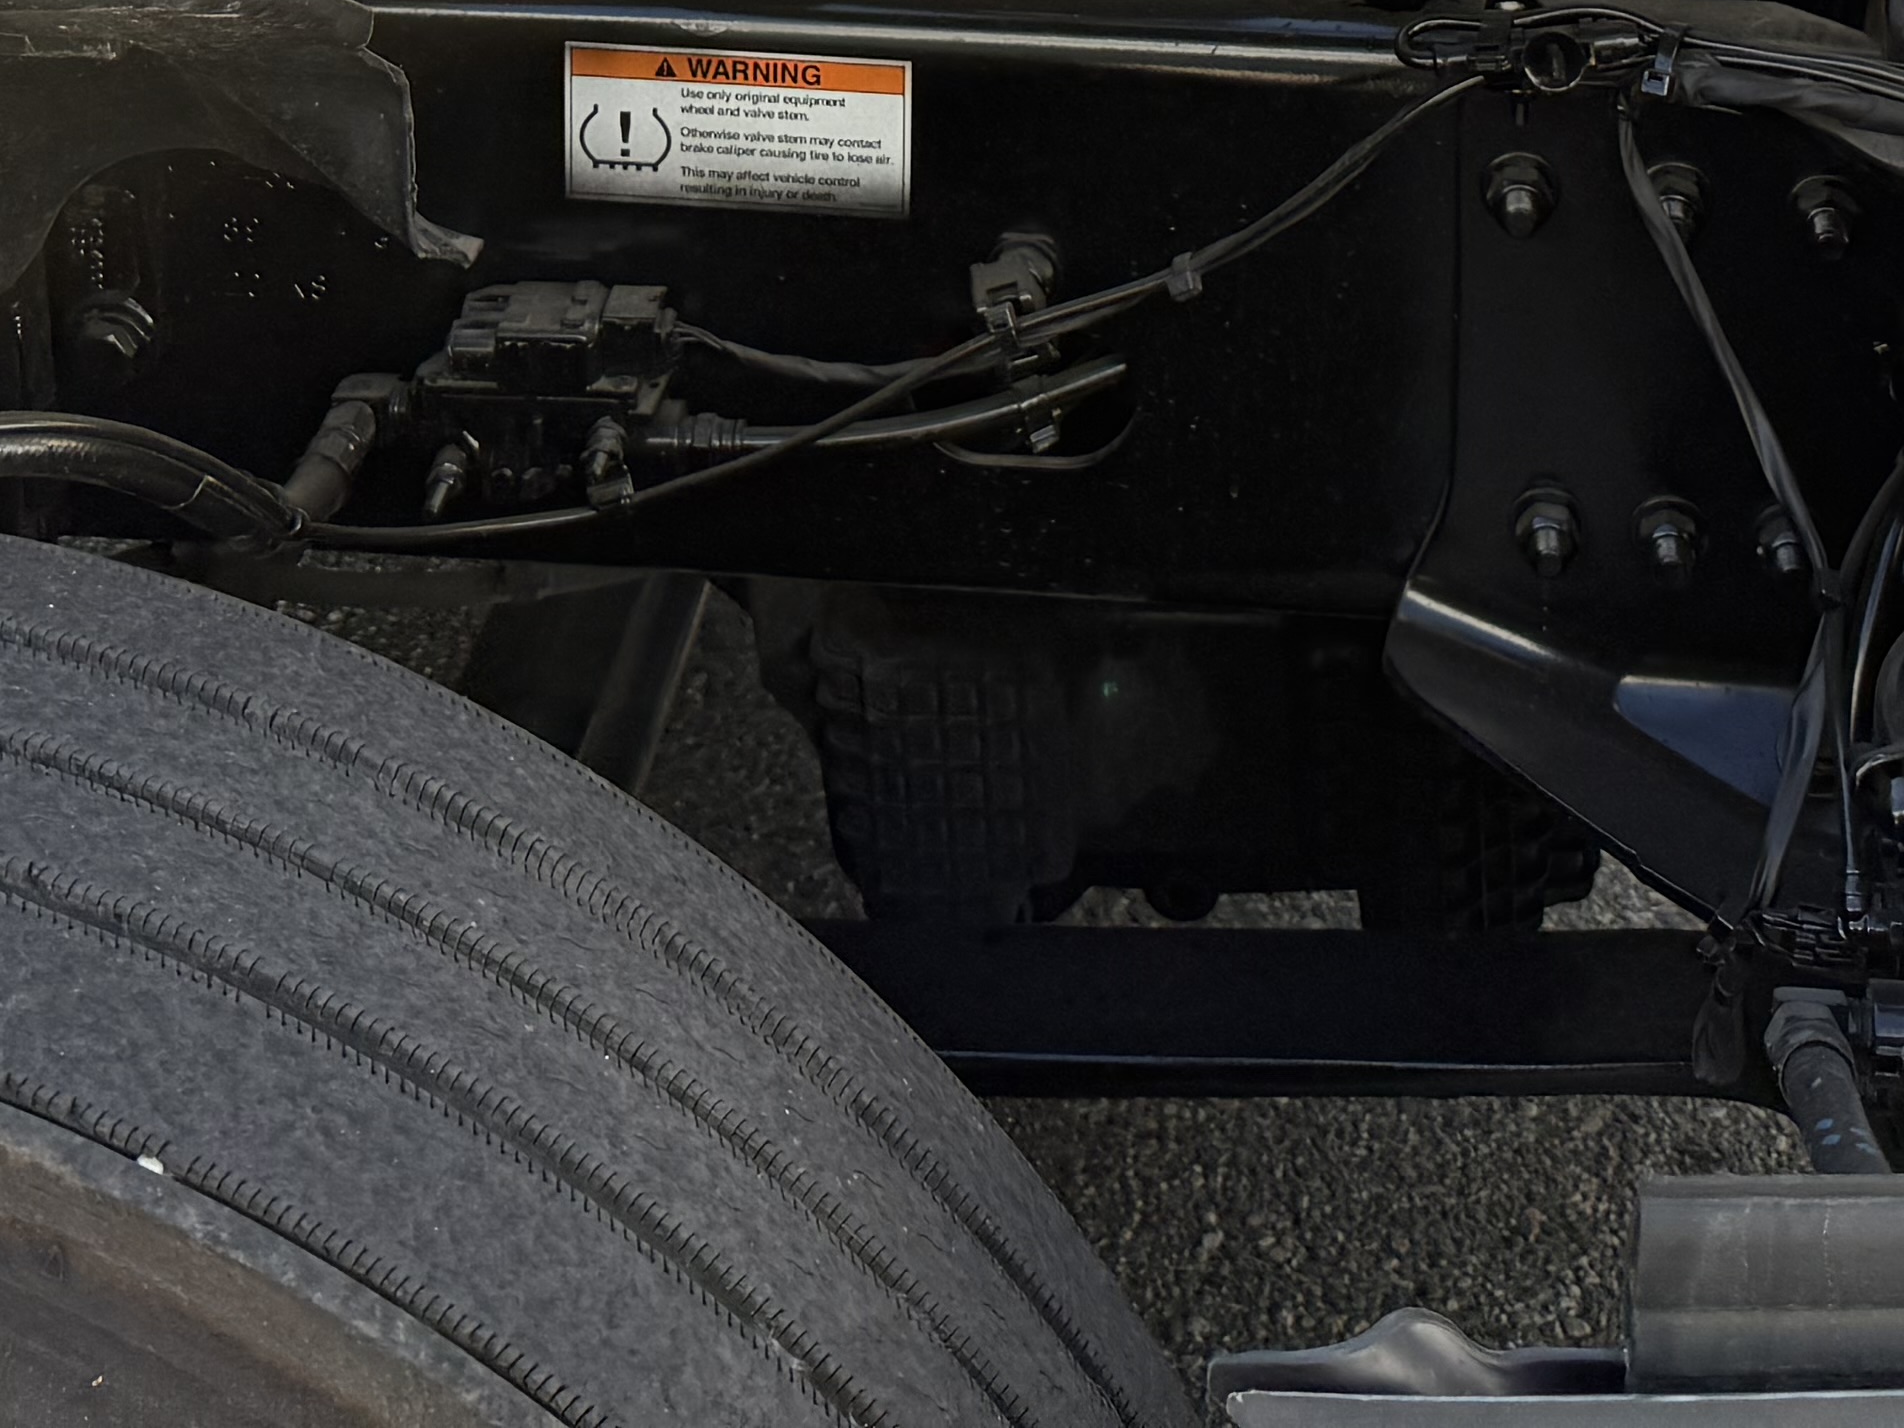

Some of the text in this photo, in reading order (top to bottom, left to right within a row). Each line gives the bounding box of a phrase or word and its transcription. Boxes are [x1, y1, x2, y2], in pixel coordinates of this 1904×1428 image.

[687, 57, 822, 86] WARNING
[680, 87, 846, 109] Use only original equipment
[680, 104, 715, 116] wheel
[717, 106, 740, 117] and
[744, 107, 775, 120] valve
[680, 127, 882, 149] Otherwise valve stem may contact
[680, 142, 714, 154] brake
[717, 143, 757, 158] caliper
[759, 146, 806, 162] causing
[809, 149, 829, 161] tire
[832, 149, 845, 161] to
[848, 152, 873, 163] lose
[680, 166, 861, 188] This may affect vehicle control
[680, 182, 733, 198] resulting
[735, 185, 747, 197] in
[749, 185, 784, 202] injury
[787, 188, 799, 198] or
